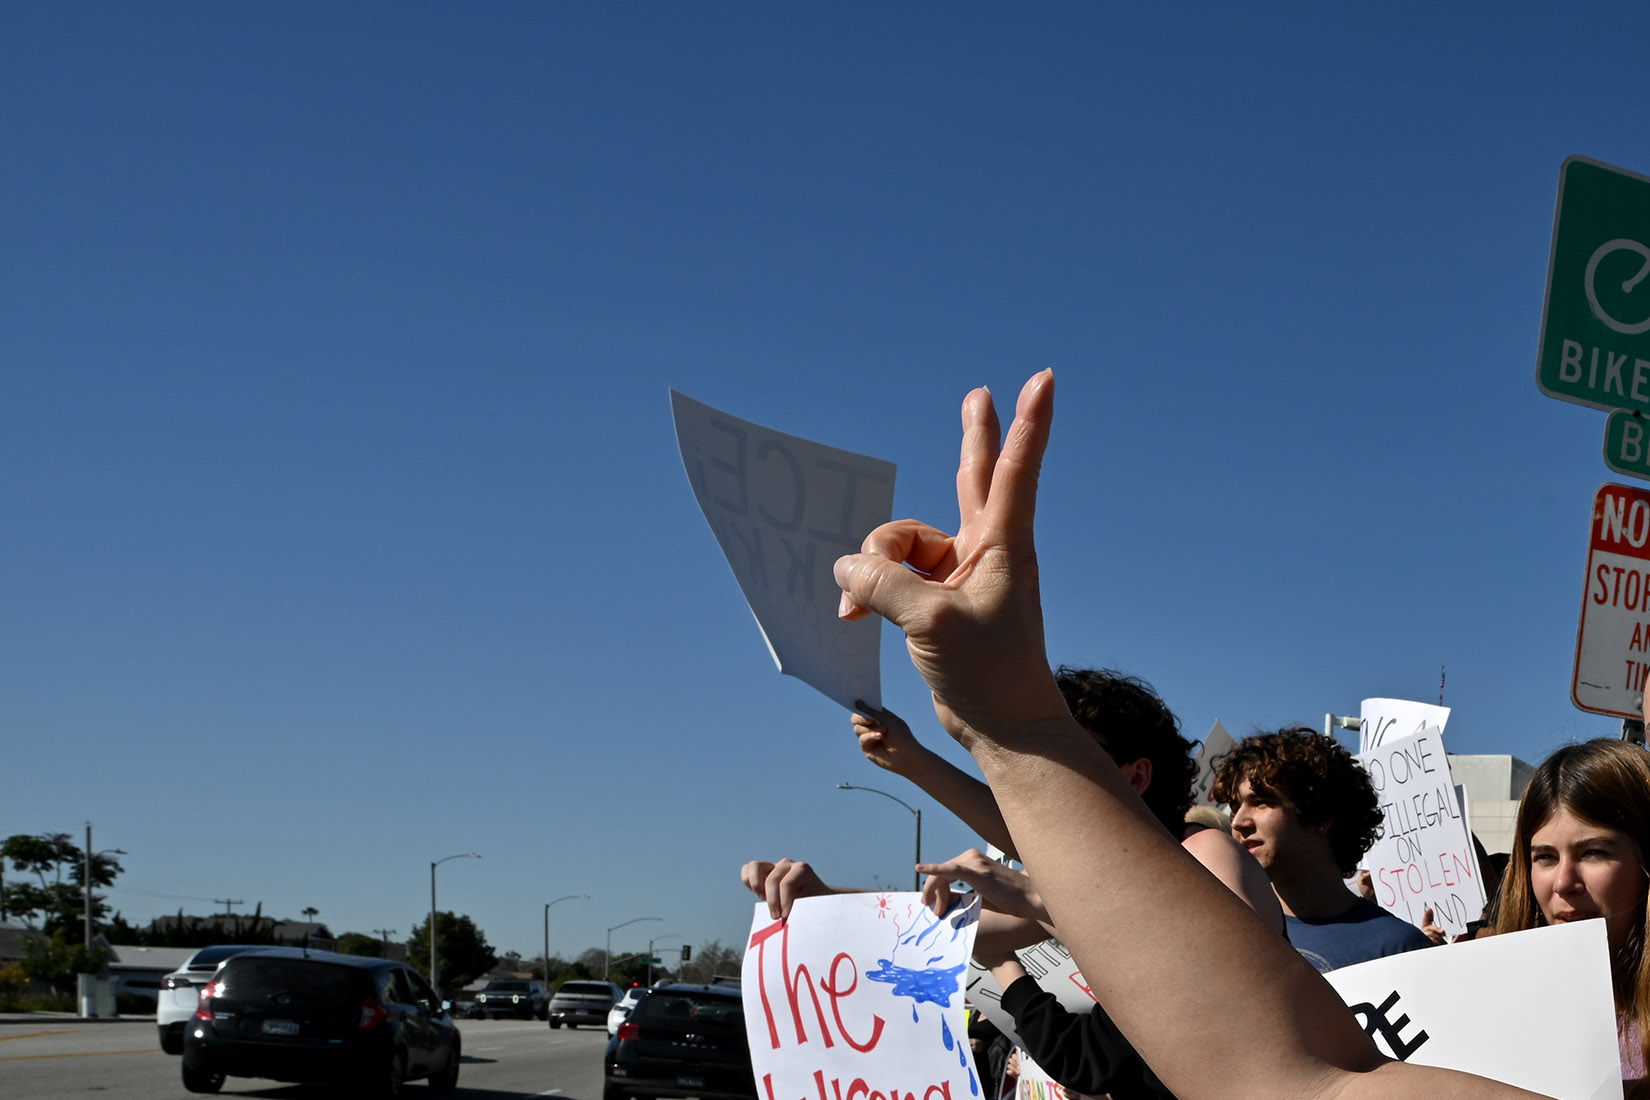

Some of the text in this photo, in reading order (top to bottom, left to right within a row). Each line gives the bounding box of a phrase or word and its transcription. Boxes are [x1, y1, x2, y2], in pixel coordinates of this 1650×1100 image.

[1599, 493, 1650, 549] NO
[1625, 660, 1648, 692] TI
[1390, 737, 1435, 784] ONE
[1382, 783, 1460, 839] ILLEGAL
[1396, 833, 1422, 864] ON
[1378, 848, 1472, 907] STOLEN
[749, 917, 886, 1053] The
